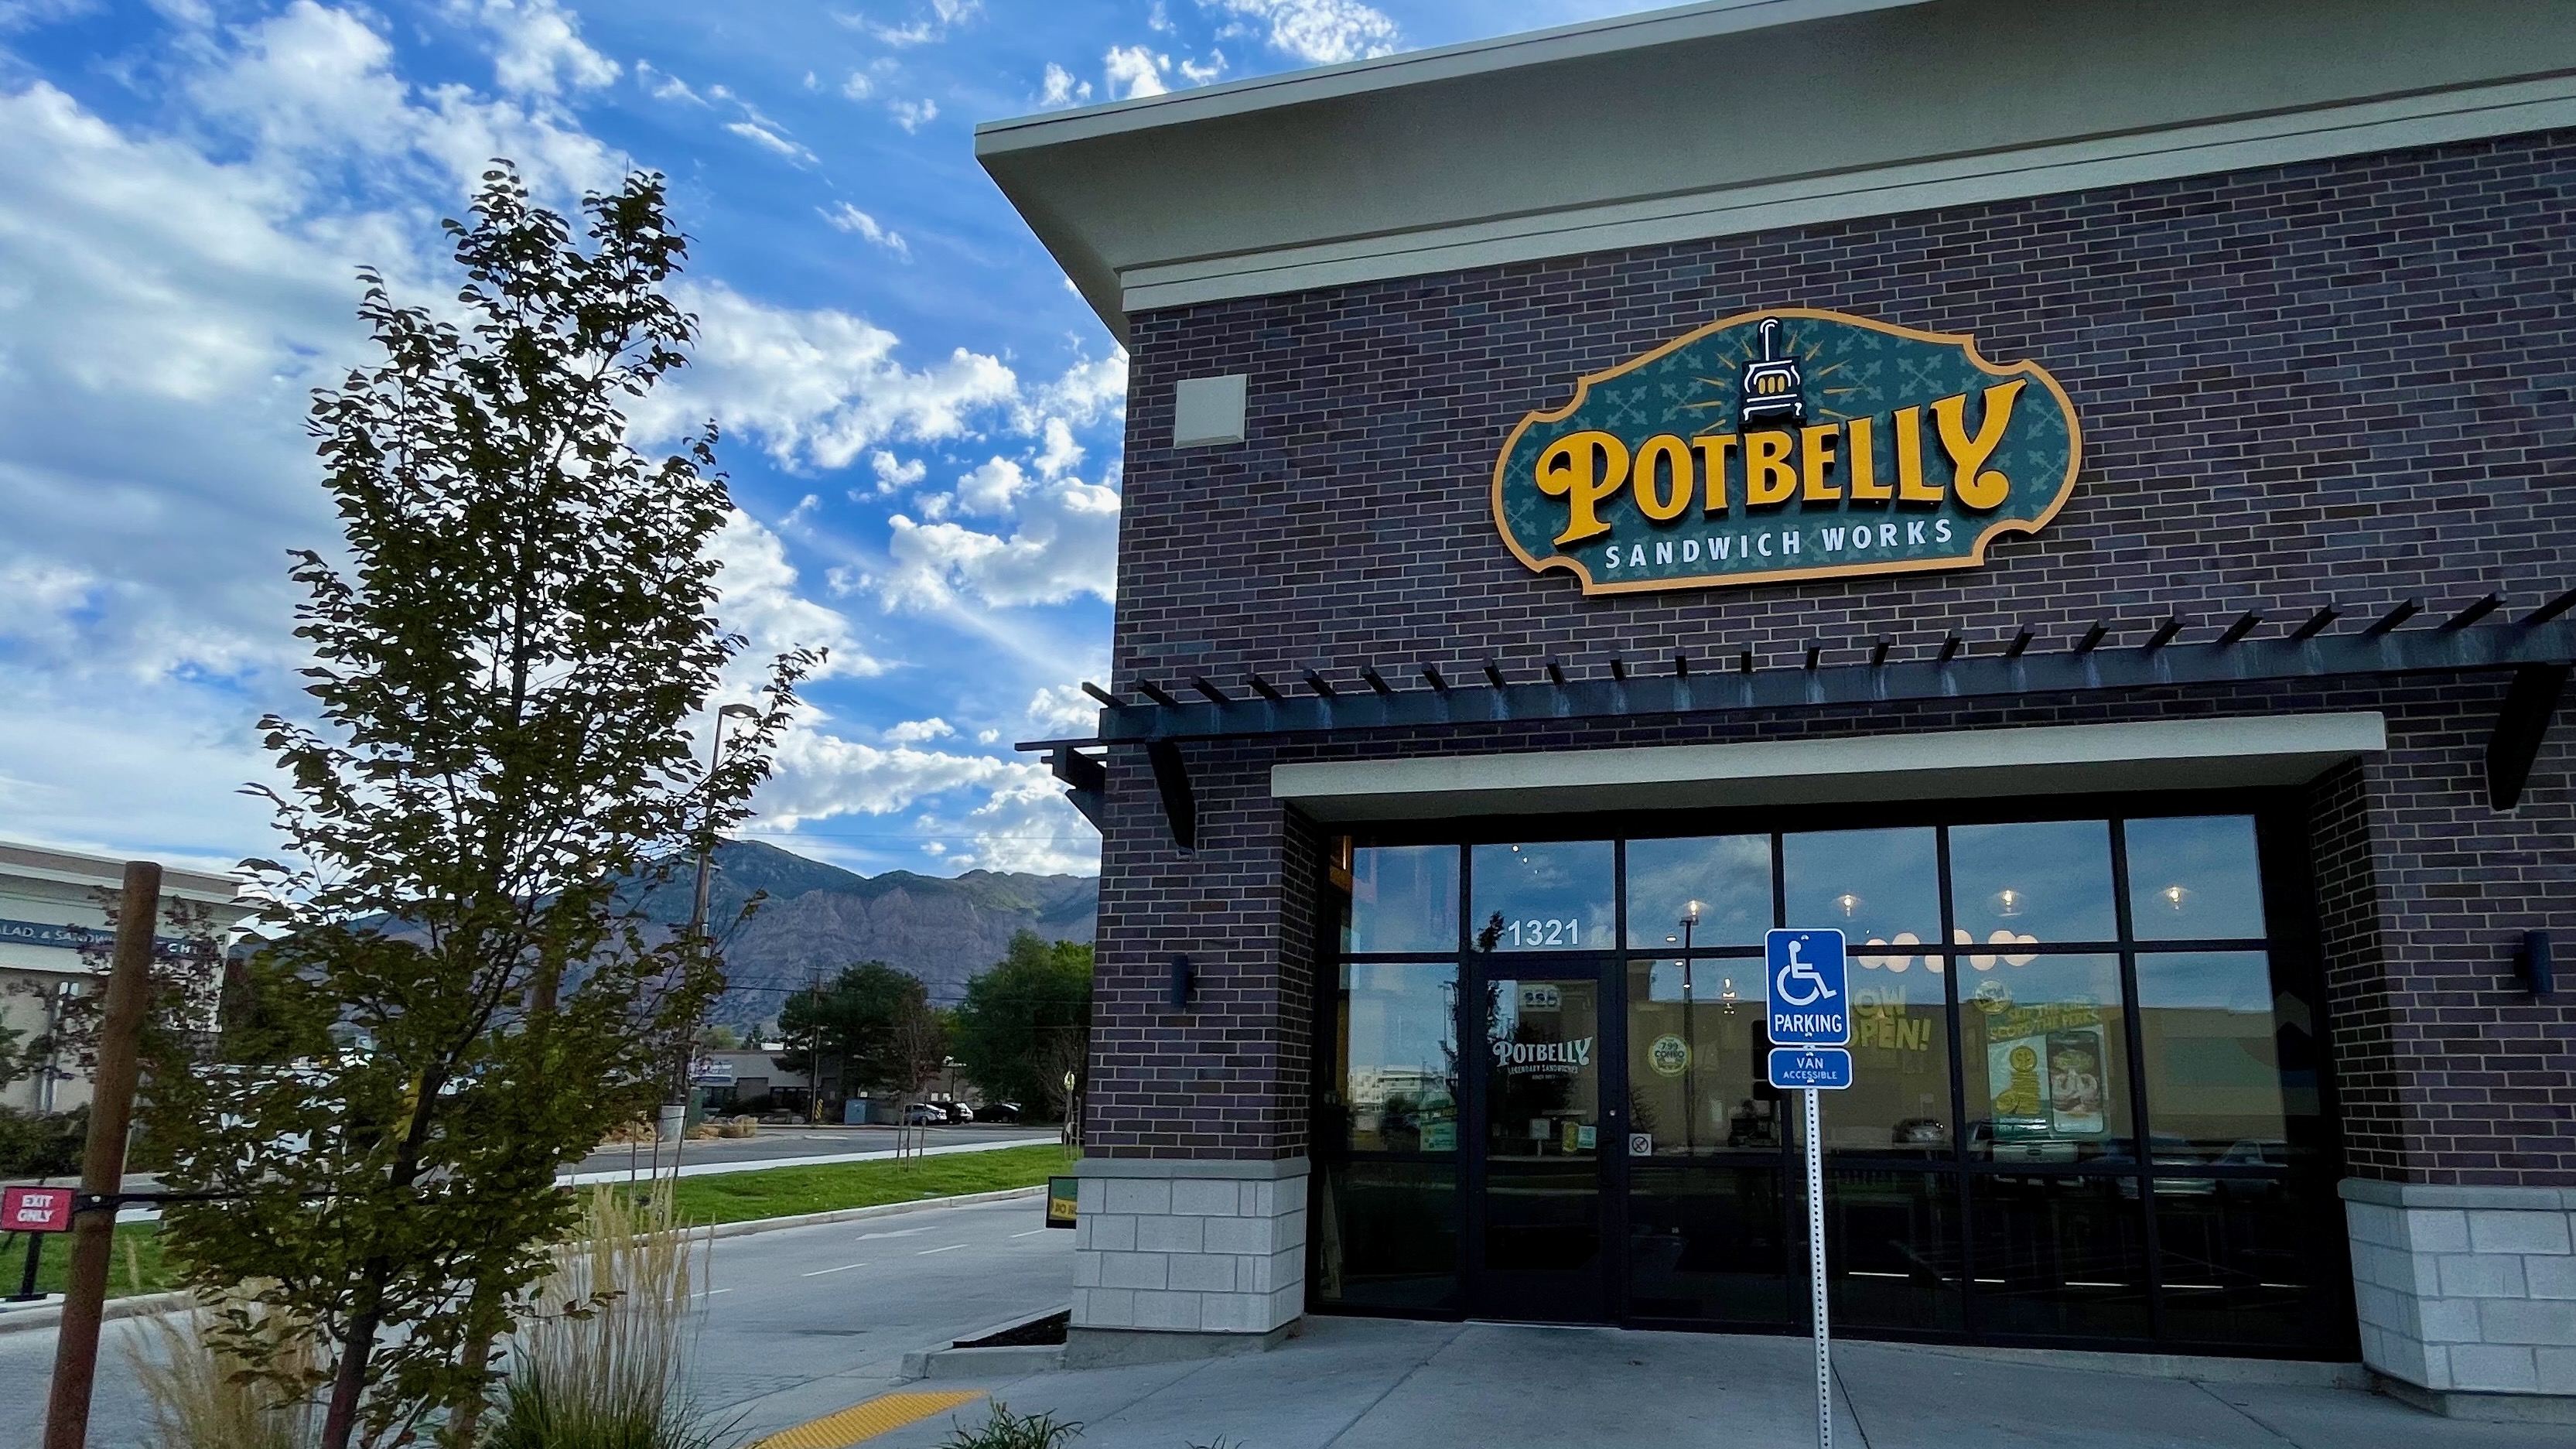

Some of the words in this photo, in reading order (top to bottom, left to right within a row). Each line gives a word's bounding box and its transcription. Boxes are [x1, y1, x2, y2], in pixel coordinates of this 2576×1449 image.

[1535, 379, 2027, 545] POTBELLY
[1605, 531, 1800, 569] SANDWICH
[1822, 519, 1952, 552] WORKS
[1508, 918, 1578, 946] 1321
[1853, 984, 1906, 1017] OW
[1774, 1013, 1843, 1033] PARKING
[1492, 1036, 1593, 1067] POTBELLY
[1796, 1057, 1824, 1069] VAN
[1782, 1070, 1838, 1080] ACCESSIBLE
[22, 1194, 53, 1207] EXIT
[17, 1208, 54, 1222] ONLY
